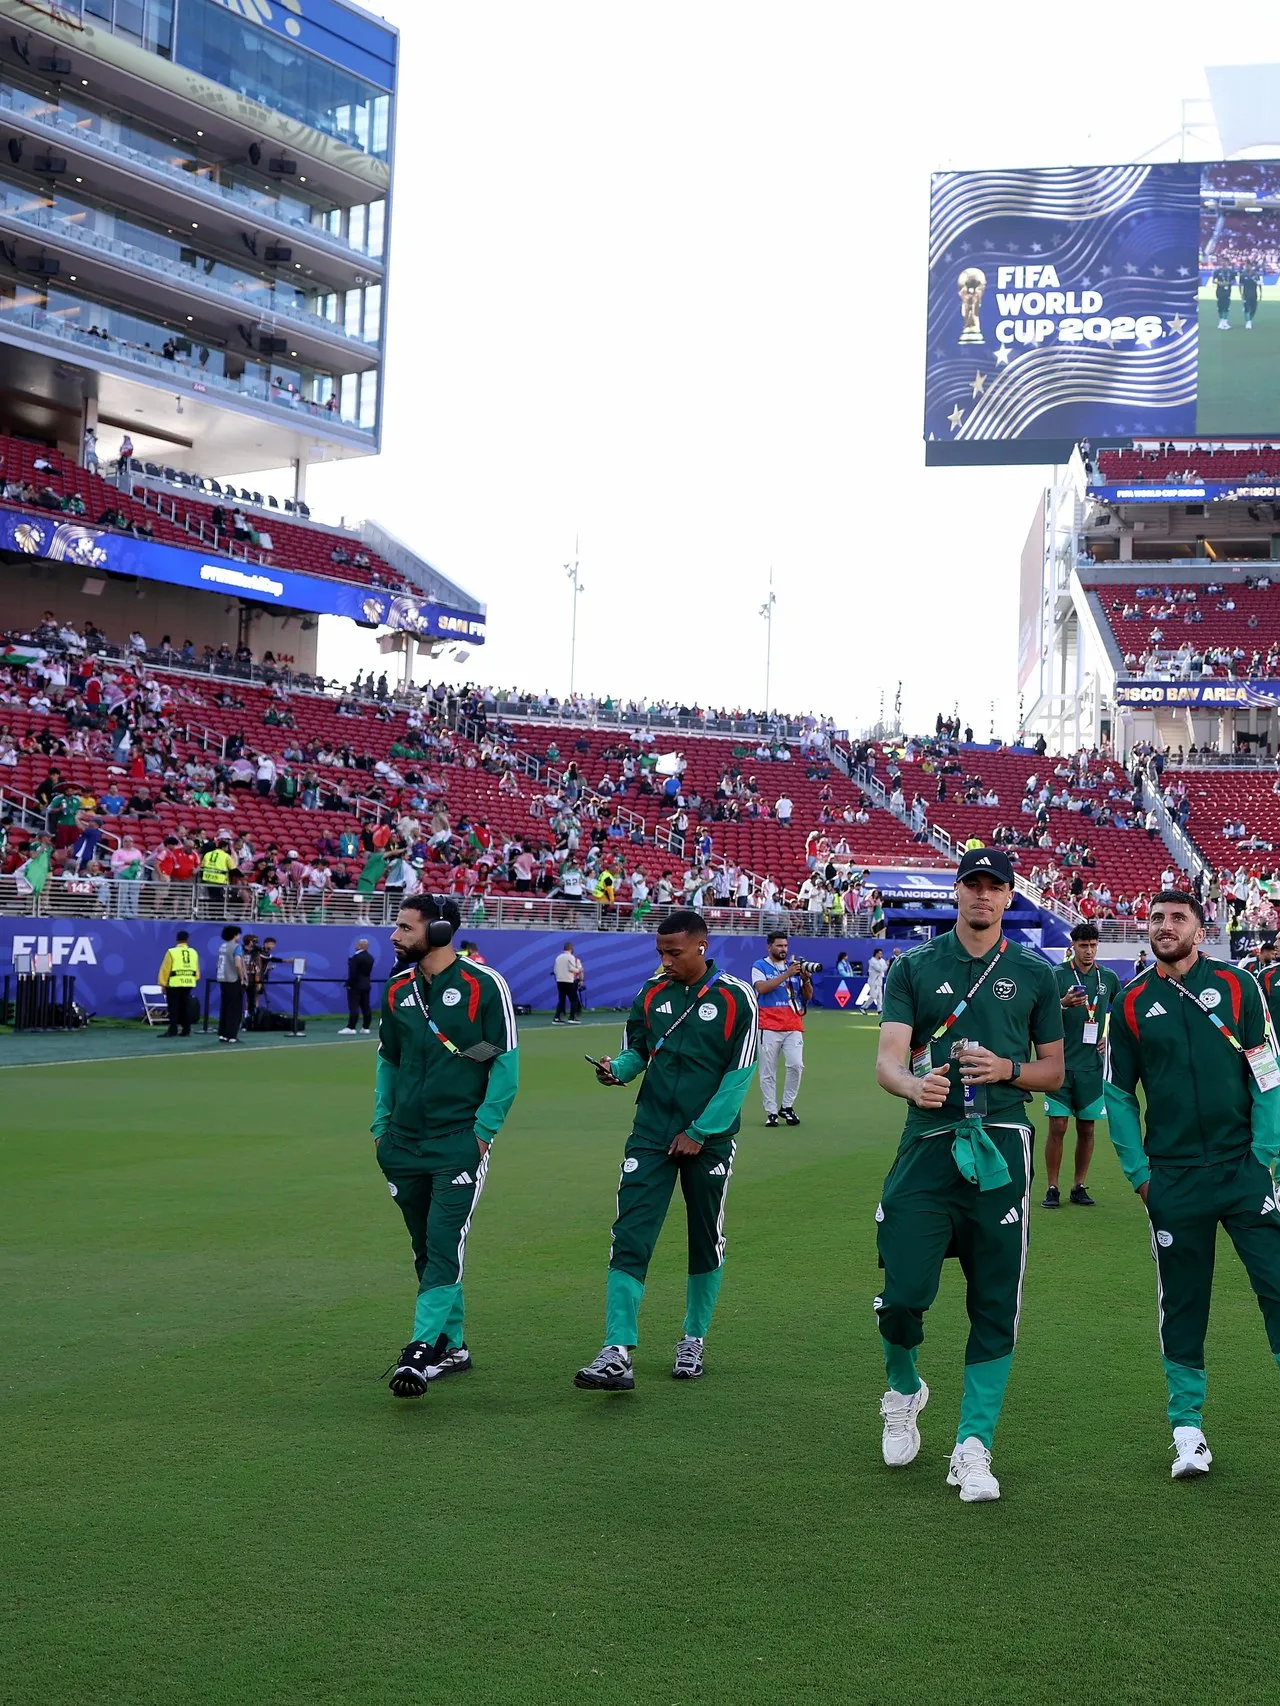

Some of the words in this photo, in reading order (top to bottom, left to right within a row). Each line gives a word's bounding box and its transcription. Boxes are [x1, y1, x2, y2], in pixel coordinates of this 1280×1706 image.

[997, 265, 1060, 288] FIFA
[996, 291, 1103, 316] WORLD
[996, 319, 1055, 343] CUP
[1058, 316, 1166, 341] 2026
[438, 615, 468, 634] SAN
[1167, 687, 1200, 702] BAY
[1202, 687, 1247, 702] AREA
[72, 882, 90, 893] 142
[882, 889, 947, 899] FRANCISCO
[12, 935, 97, 965] FIFA
